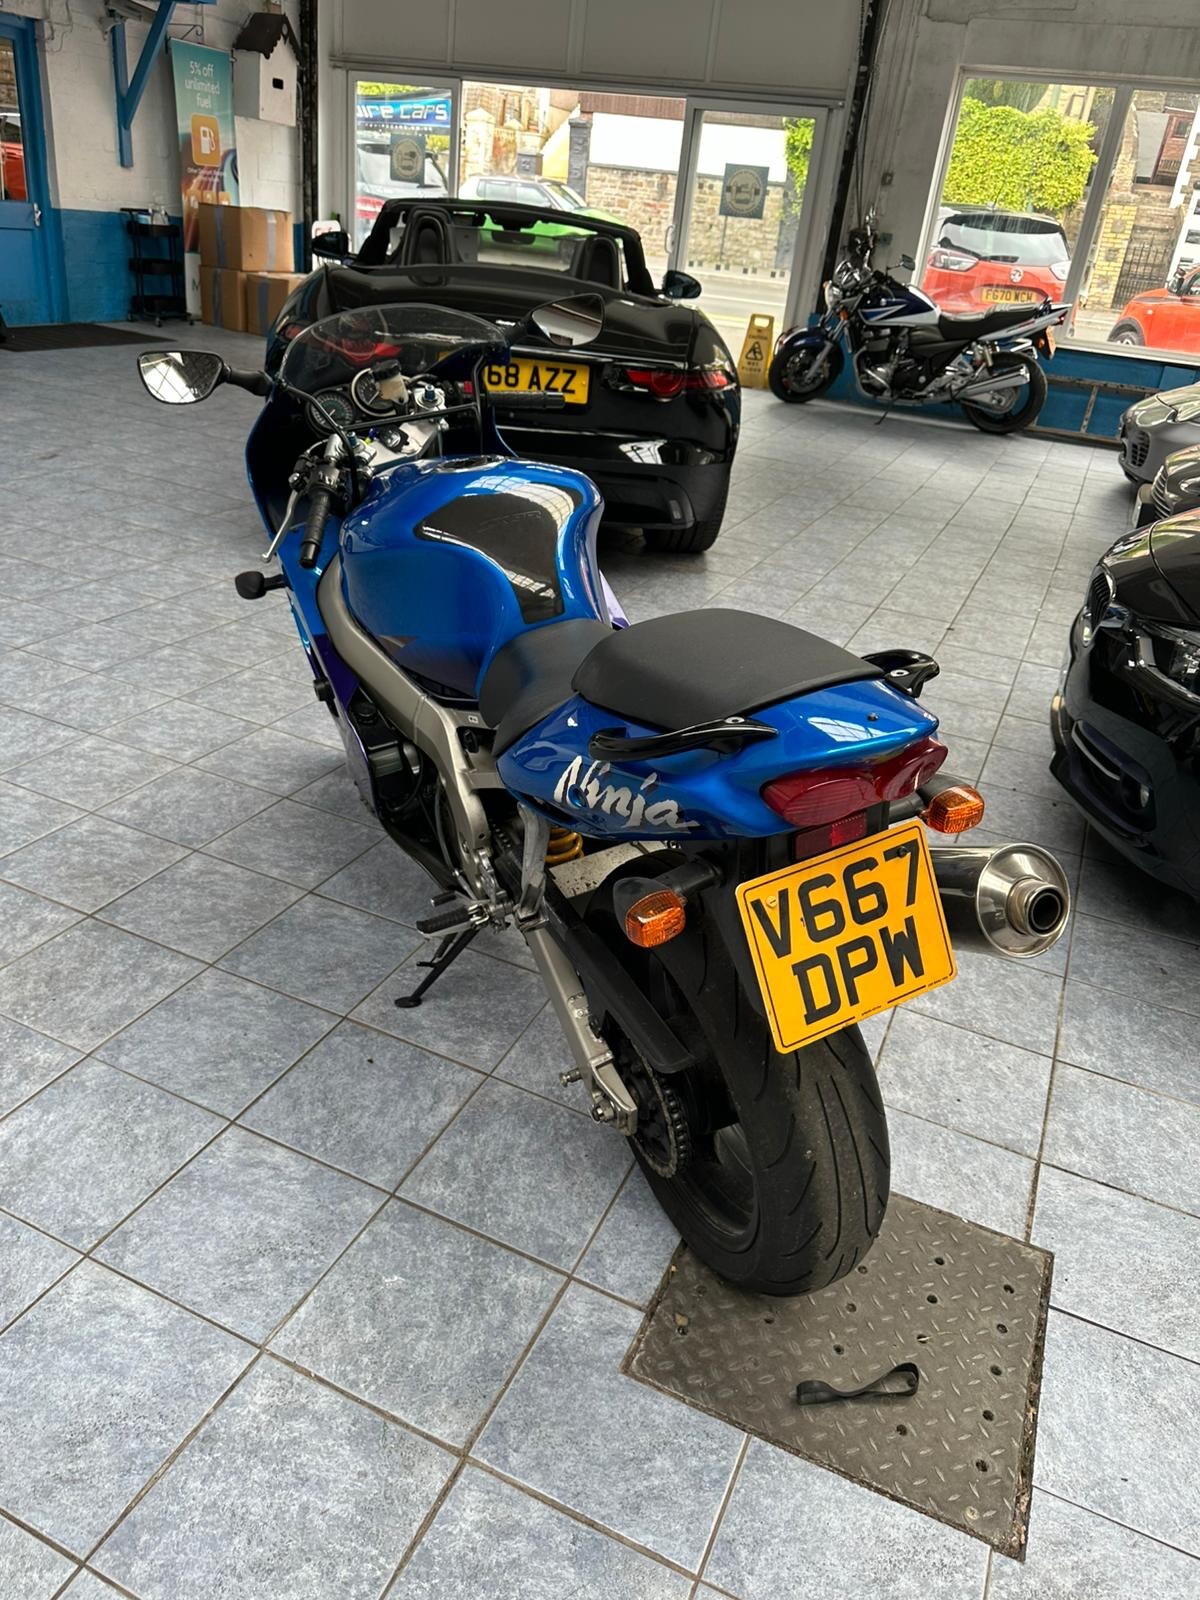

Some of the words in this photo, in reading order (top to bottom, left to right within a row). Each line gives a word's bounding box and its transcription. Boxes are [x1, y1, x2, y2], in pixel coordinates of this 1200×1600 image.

[202, 63, 214, 77] off
[400, 104, 448, 120] cars
[528, 366, 577, 394] AZZ
[554, 755, 700, 828] Ninja
[750, 839, 920, 958] V667
[792, 915, 924, 1025] DPW
